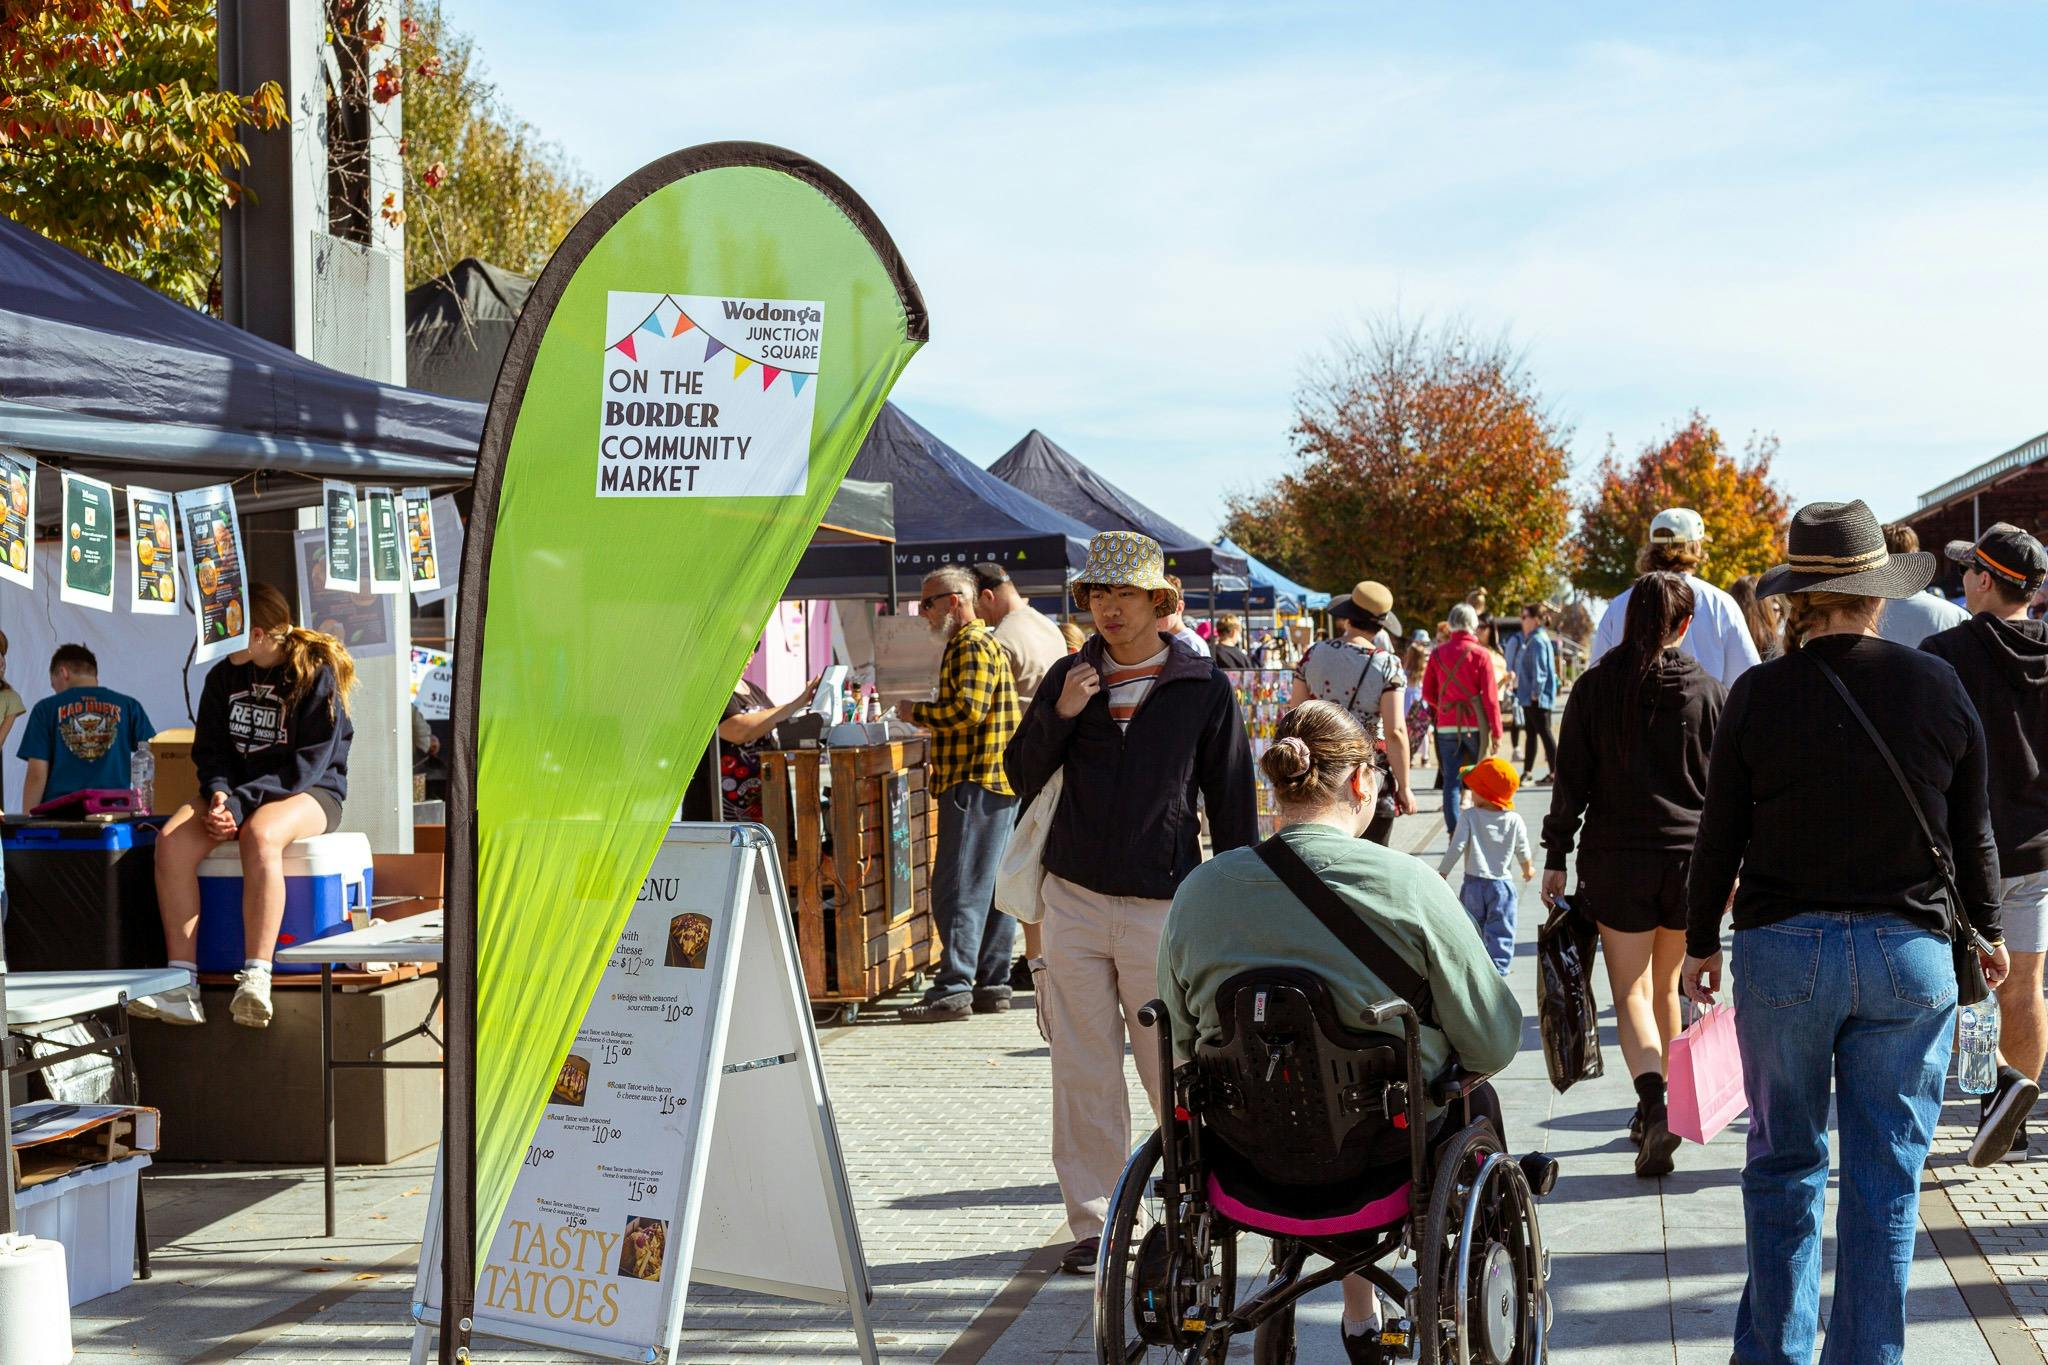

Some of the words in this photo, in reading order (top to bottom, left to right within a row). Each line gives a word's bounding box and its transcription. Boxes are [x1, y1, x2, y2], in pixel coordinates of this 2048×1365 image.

[722, 300, 821, 326] Wodonga
[746, 327, 819, 342] JUNCTION
[761, 345, 818, 359] SQUARE
[609, 368, 649, 394] ON
[660, 370, 704, 395] THE
[604, 400, 720, 428] BORDER
[601, 435, 752, 461] COMMUNITY
[601, 465, 700, 492] MARKET
[229, 704, 279, 729] REGIO
[636, 878, 680, 902] ENU
[621, 930, 639, 942] with
[616, 943, 643, 956] chesse
[616, 993, 638, 1003] Wedges
[638, 993, 652, 1002] with
[651, 995, 678, 1003] seasoned
[611, 1081, 627, 1090] Roast
[627, 1082, 642, 1091] Tatoe
[642, 1083, 655, 1092] with
[654, 1085, 672, 1094] bacon
[616, 1091, 622, 1099] &
[622, 1092, 640, 1100] cheese
[550, 1113, 565, 1121] Roast
[565, 1114, 578, 1122] Tatoe
[589, 1117, 611, 1125] seasoned
[508, 1219, 620, 1276] TASTY
[483, 1263, 620, 1328] TATOES
